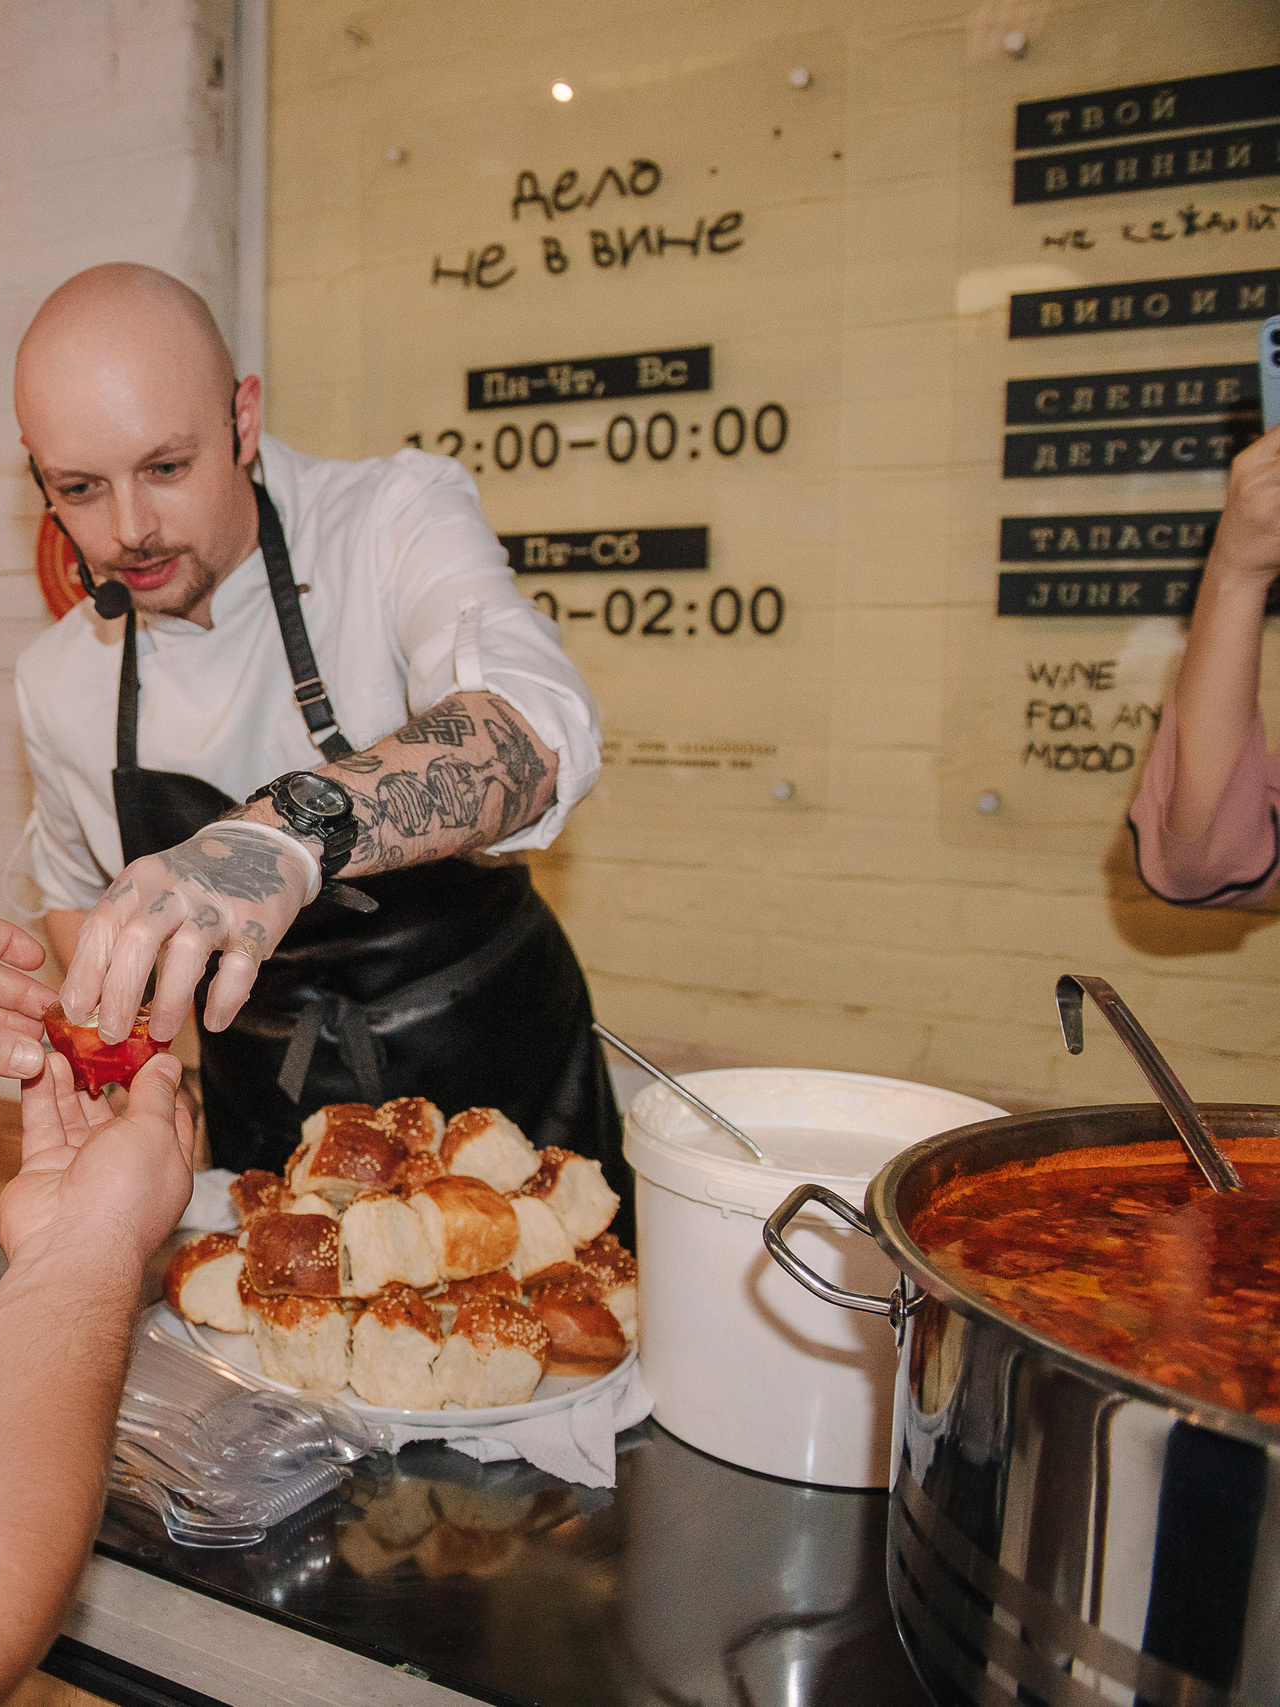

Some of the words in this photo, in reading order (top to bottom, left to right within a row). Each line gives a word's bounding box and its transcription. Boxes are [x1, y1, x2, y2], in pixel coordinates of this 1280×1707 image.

[1045, 88, 1177, 136] ТВОЙ
[1045, 138, 1252, 192] ВИННЫЙ
[589, 210, 744, 268] вине
[1040, 292, 1170, 328] ВИНО
[1190, 288, 1218, 315] И
[636, 355, 689, 388] Вс
[1035, 378, 1241, 414] СЛЕПЫЕ
[524, 532, 641, 567] Пт-Сб
[1027, 582, 1142, 608] JUNK
[1027, 658, 1118, 692] WINE
[1024, 698, 1095, 732] FOR
[1023, 740, 1135, 773] MOOD
